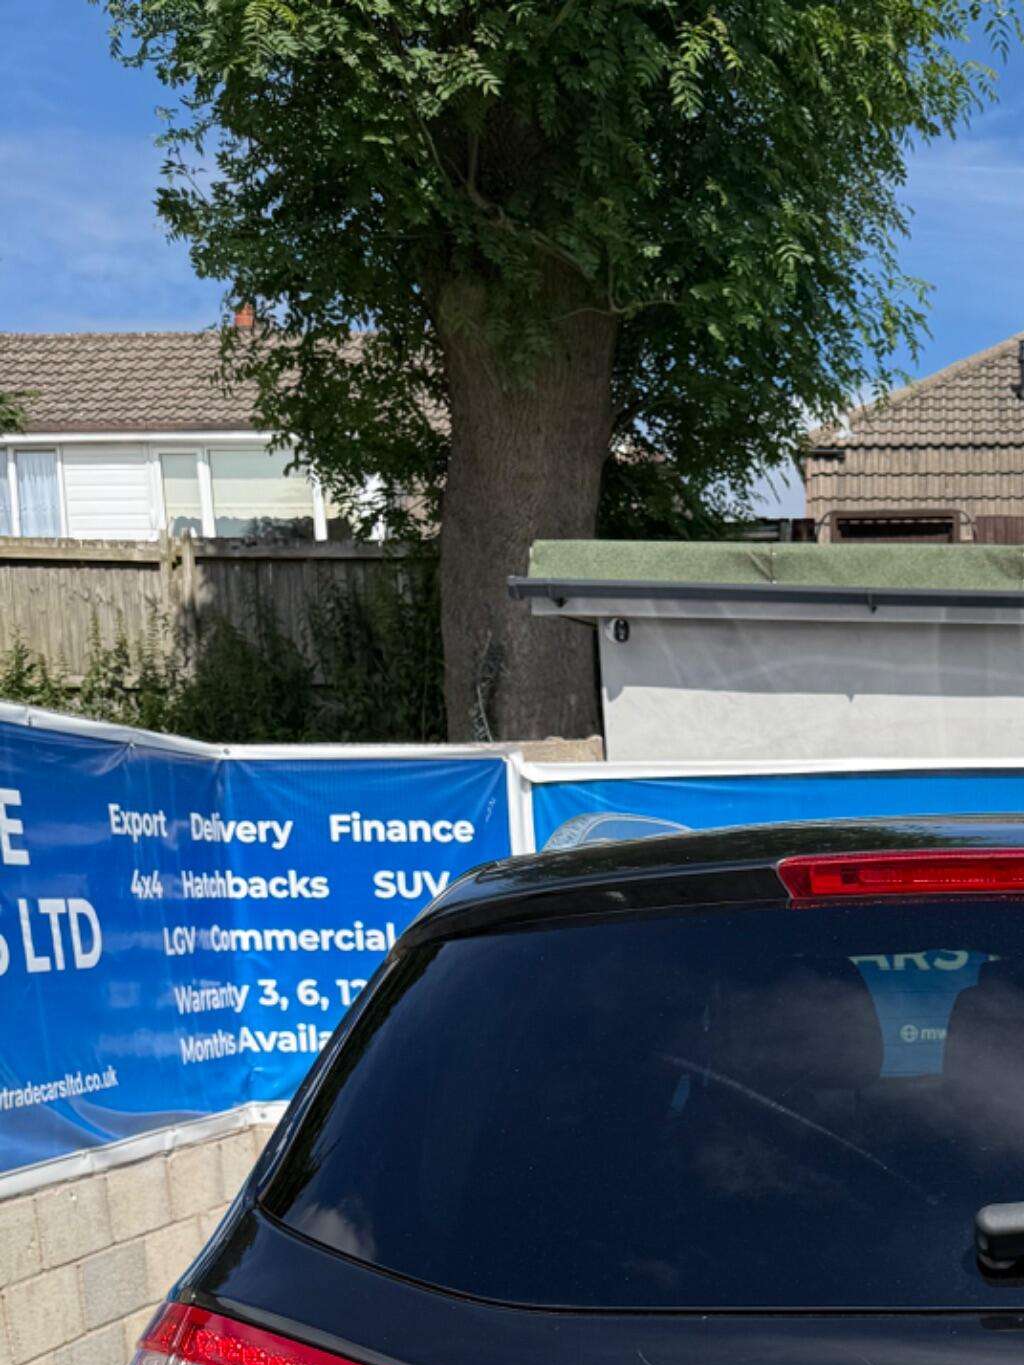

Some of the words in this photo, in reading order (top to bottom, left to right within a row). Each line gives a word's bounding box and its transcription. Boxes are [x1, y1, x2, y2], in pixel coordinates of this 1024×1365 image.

[108, 803, 168, 843] Export
[190, 812, 293, 850] Delivery
[329, 811, 475, 843] Finance
[131, 869, 163, 898] 4x4
[181, 870, 330, 899] Hatchbacks
[373, 869, 450, 899] SUV
[18, 897, 102, 973] LTD
[163, 926, 196, 956] LGV
[210, 920, 396, 952] Commercial
[174, 983, 250, 1014] Warranty
[257, 978, 289, 1011] 3,
[297, 978, 329, 1011] 6,
[180, 1029, 236, 1065] Months
